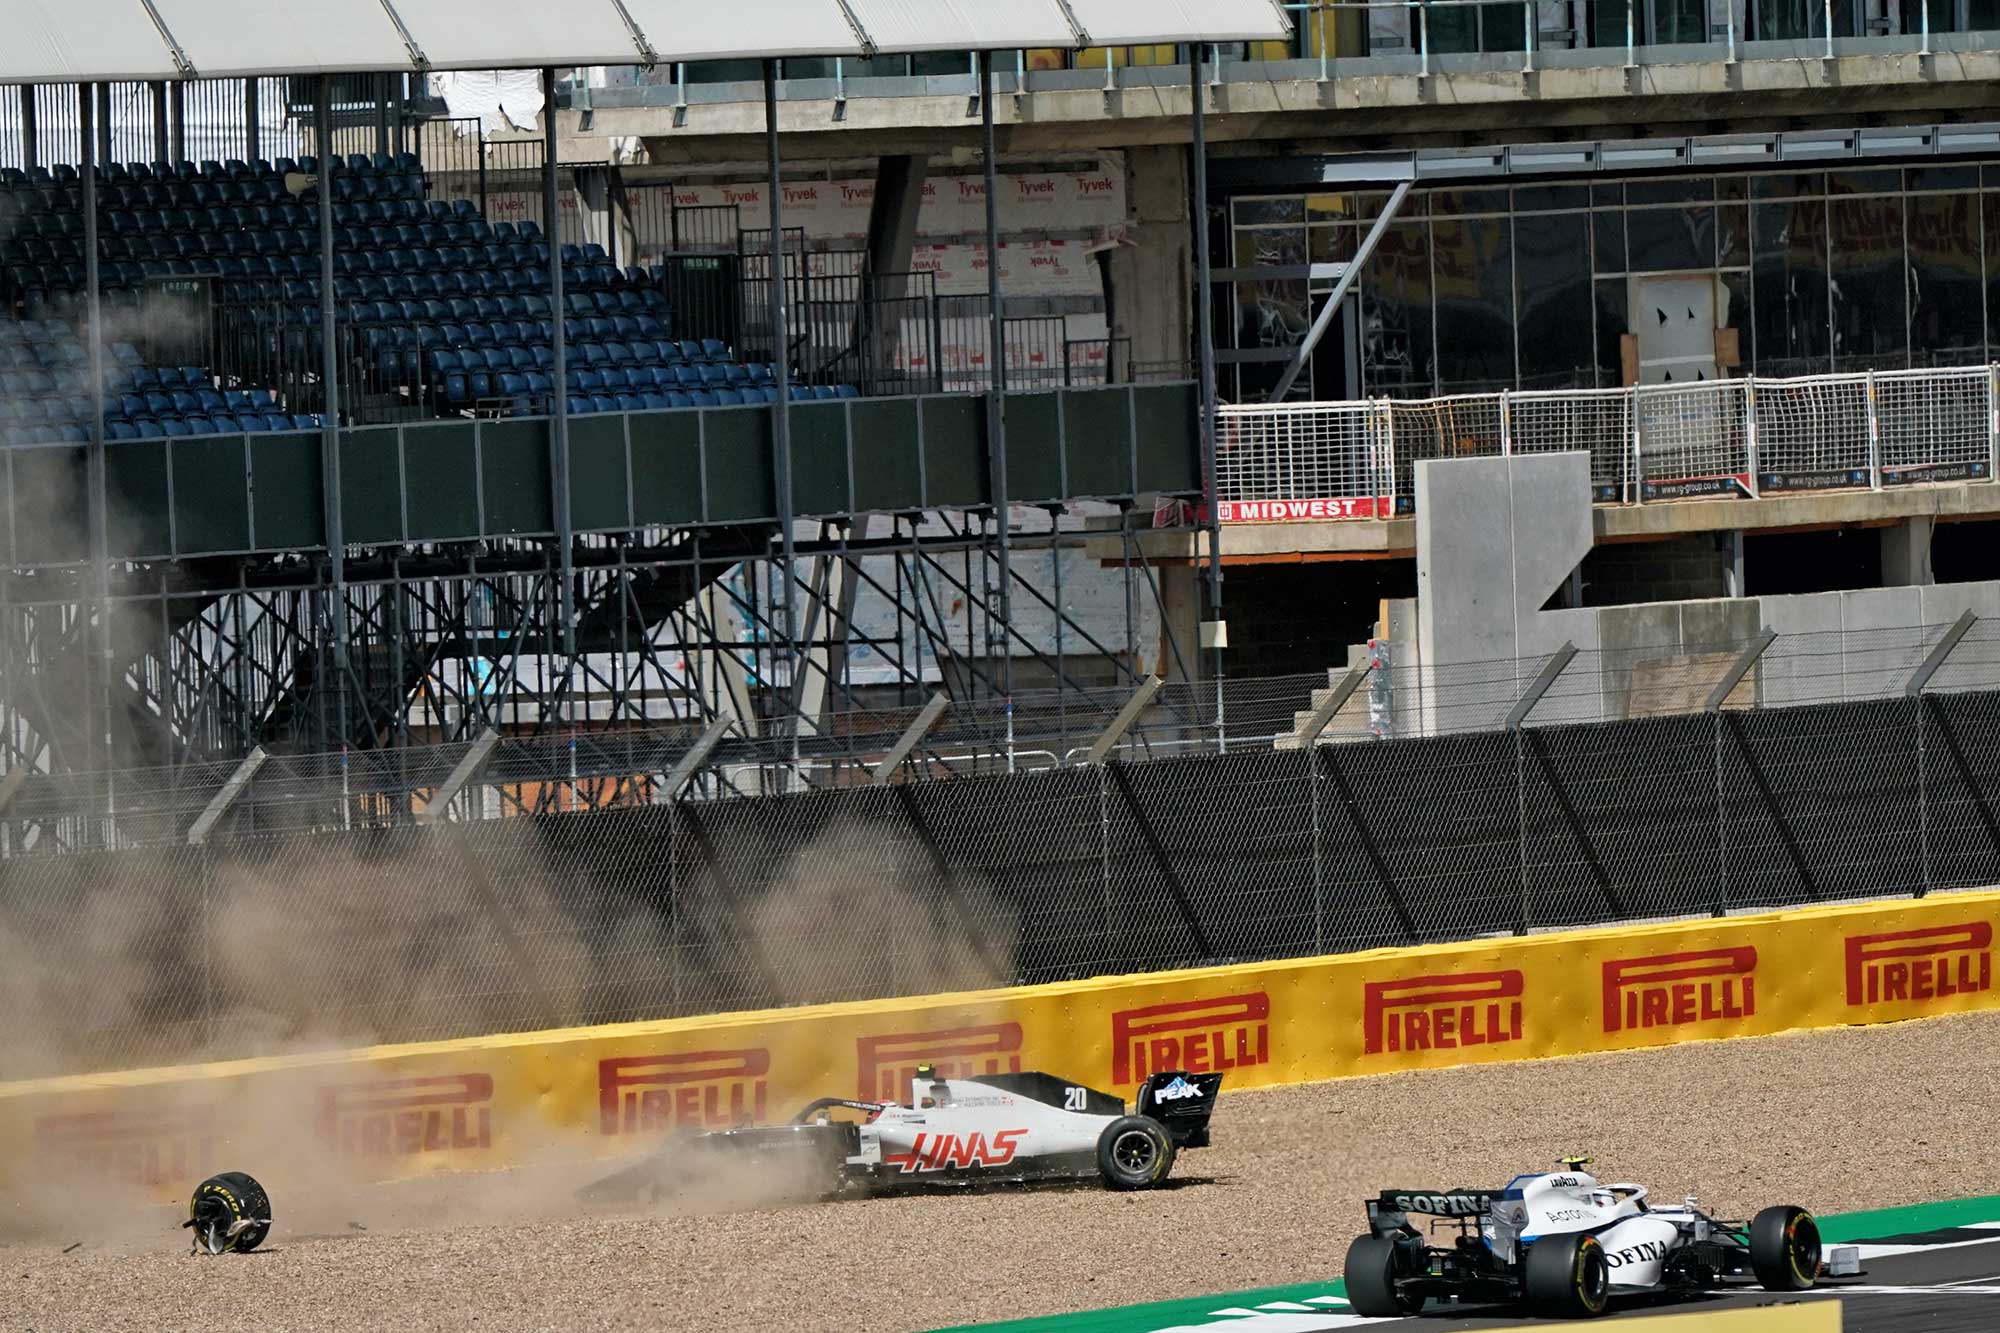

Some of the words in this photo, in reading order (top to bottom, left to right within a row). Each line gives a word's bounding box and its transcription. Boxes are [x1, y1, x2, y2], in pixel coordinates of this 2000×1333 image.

[722, 188, 760, 205] Tyvek
[782, 186, 817, 203] Tyvek
[958, 181, 985, 196] Tyve
[1018, 180, 1054, 195] Tyvek
[1076, 178, 1112, 193] Tyvek
[1240, 500, 1356, 519] MIDWEST
[1844, 921, 1993, 1006] PIRELLI
[1602, 945, 1758, 1033] PIRELLI
[1363, 969, 1524, 1055] PIRELLI
[1112, 991, 1270, 1086] PIRELLI
[598, 1047, 770, 1136] PIRELLI
[1064, 1087, 1087, 1110] 20
[1154, 1083, 1204, 1105] PEAK
[315, 1072, 494, 1158] PIRELLI
[884, 1129, 1029, 1173] HAAS
[1550, 1176, 1579, 1188] LAVAZZA
[213, 1185, 240, 1212] ZERO
[1395, 1194, 1491, 1215] SOFINA
[1604, 1240, 1667, 1268] OFINA
